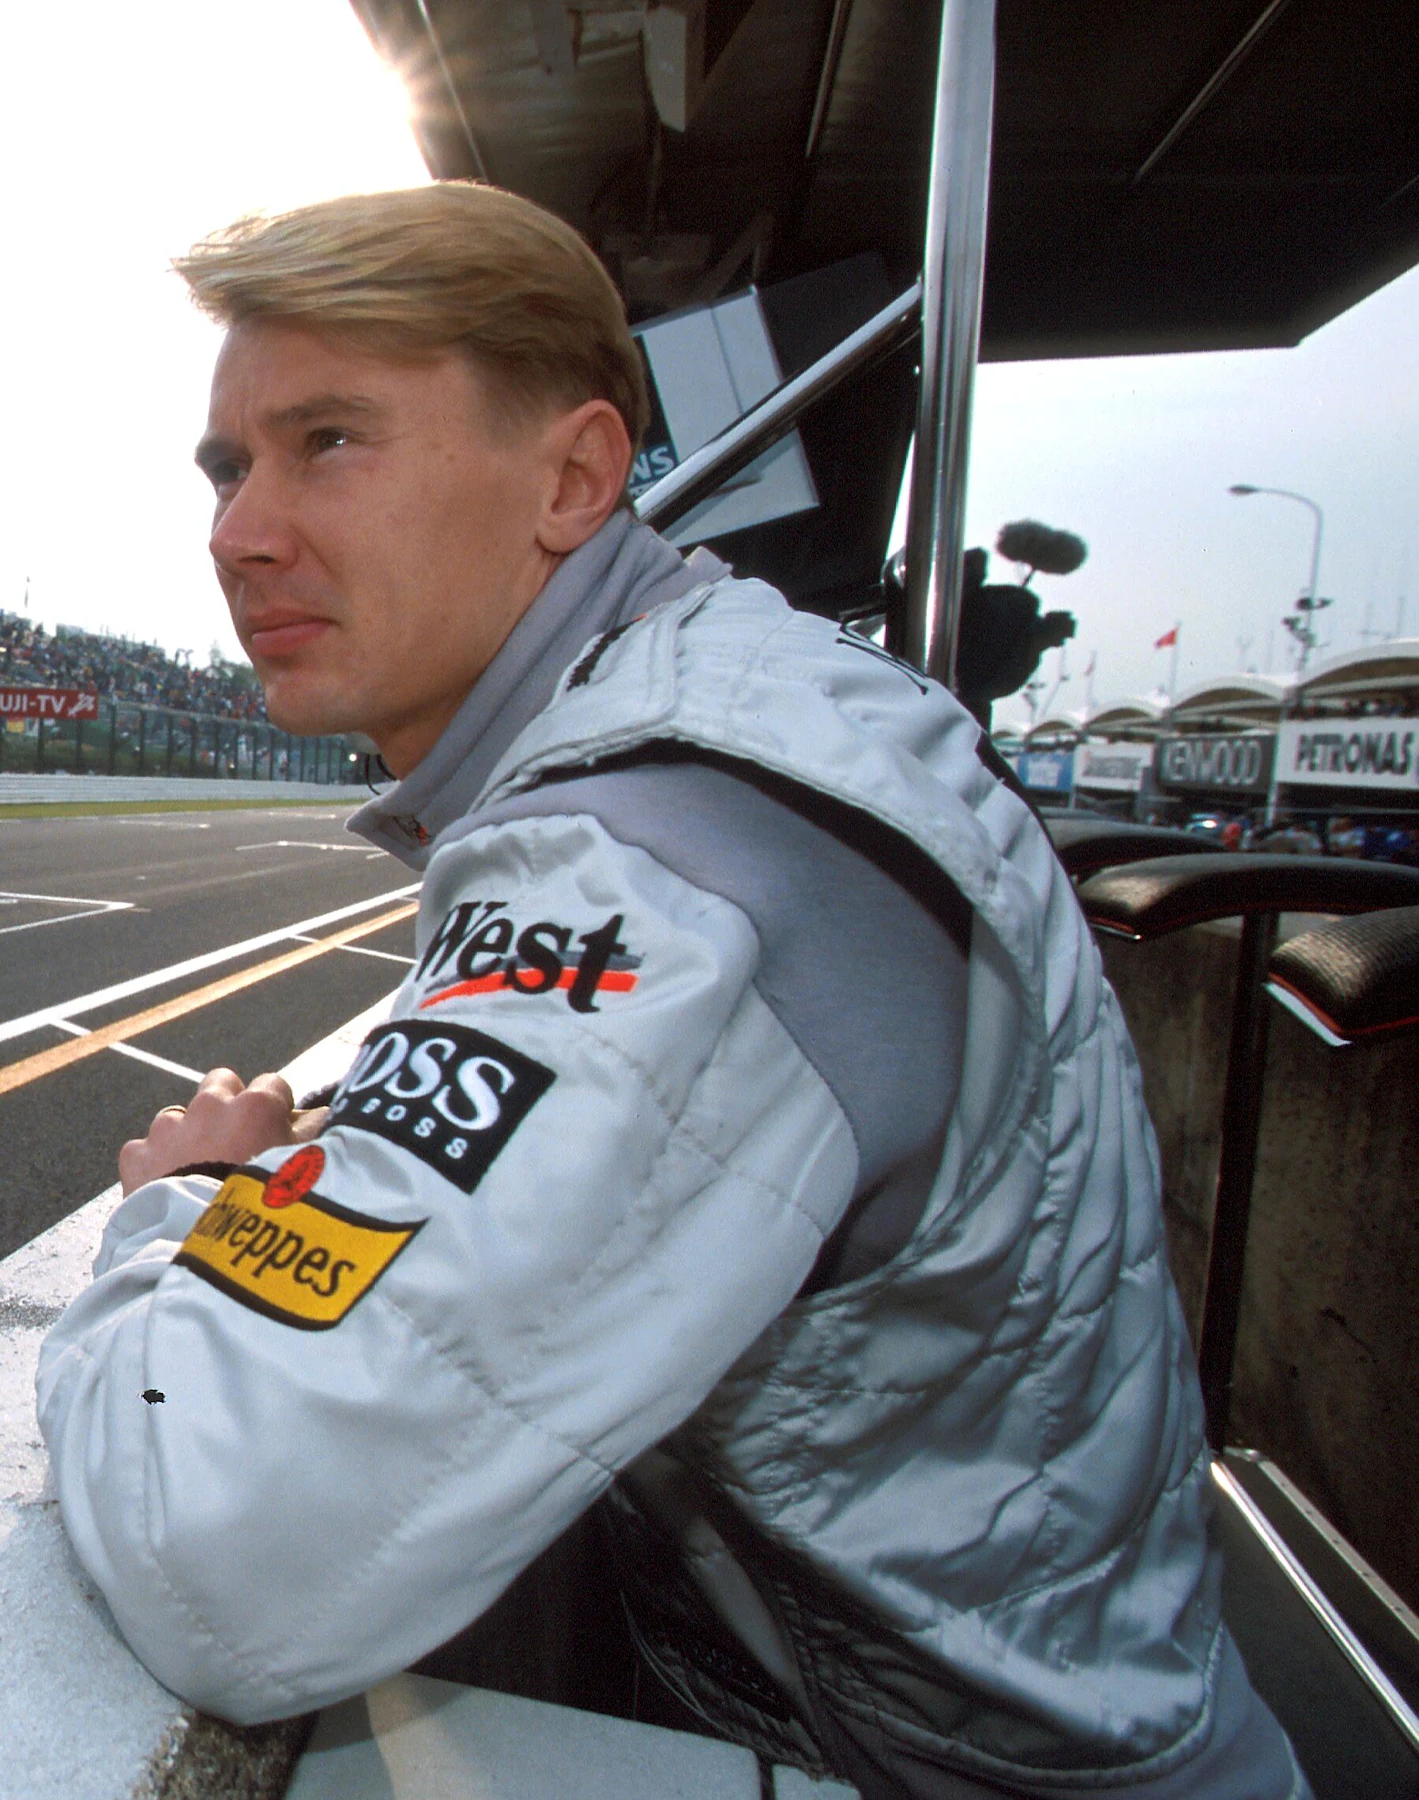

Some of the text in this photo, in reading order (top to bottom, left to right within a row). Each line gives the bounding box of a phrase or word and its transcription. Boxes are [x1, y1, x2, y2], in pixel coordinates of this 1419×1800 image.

[1161, 739, 1264, 785] KENWOOD
[1296, 730, 1415, 776] PETRONAS
[414, 900, 628, 1014] West
